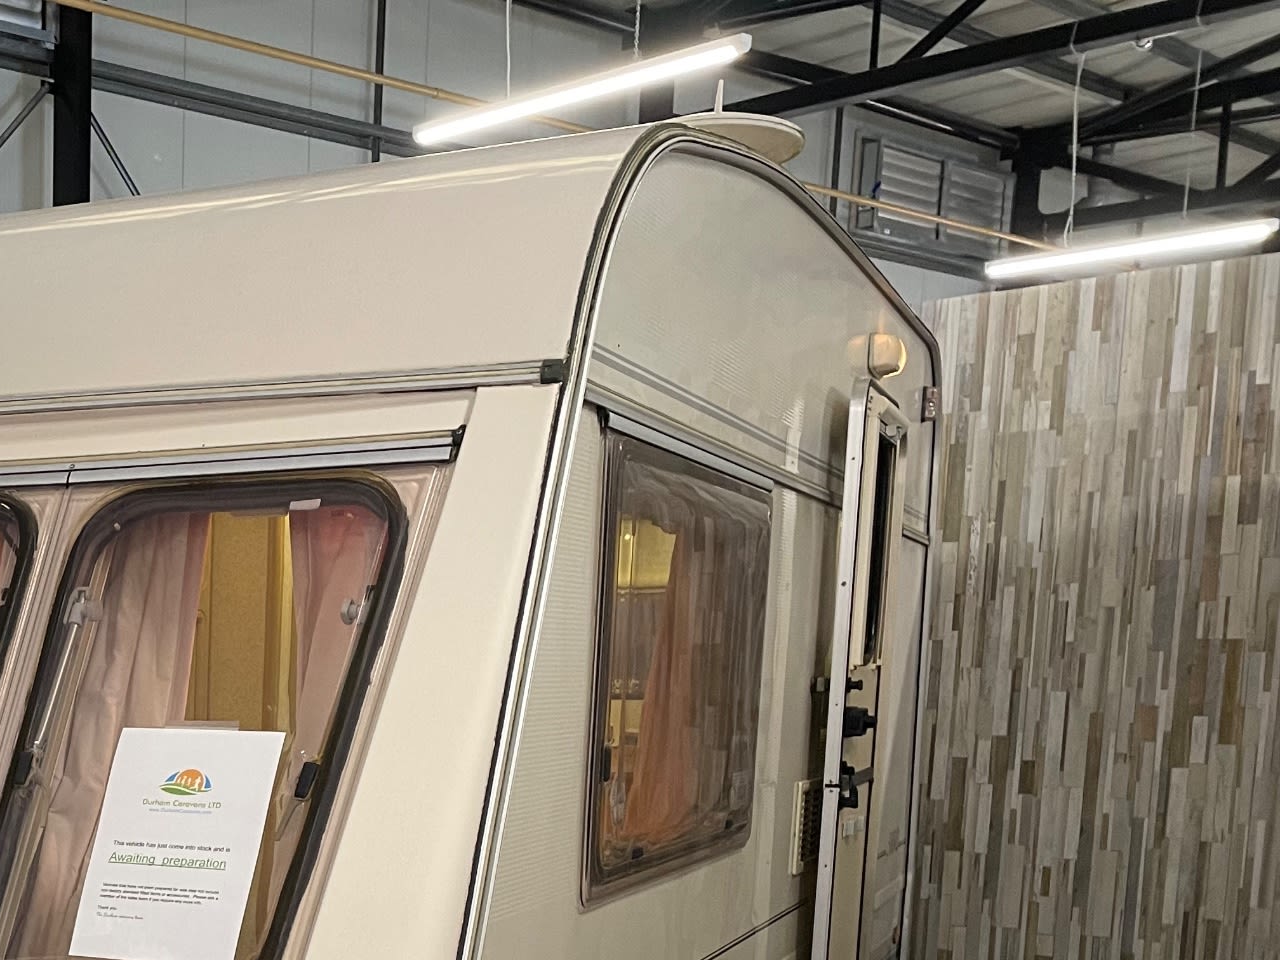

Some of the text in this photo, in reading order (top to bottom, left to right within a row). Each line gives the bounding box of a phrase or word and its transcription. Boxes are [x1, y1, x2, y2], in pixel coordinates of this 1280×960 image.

[143, 798, 170, 806] Durham
[208, 801, 222, 809] LTD
[109, 851, 227, 870] Awaiting preparation
